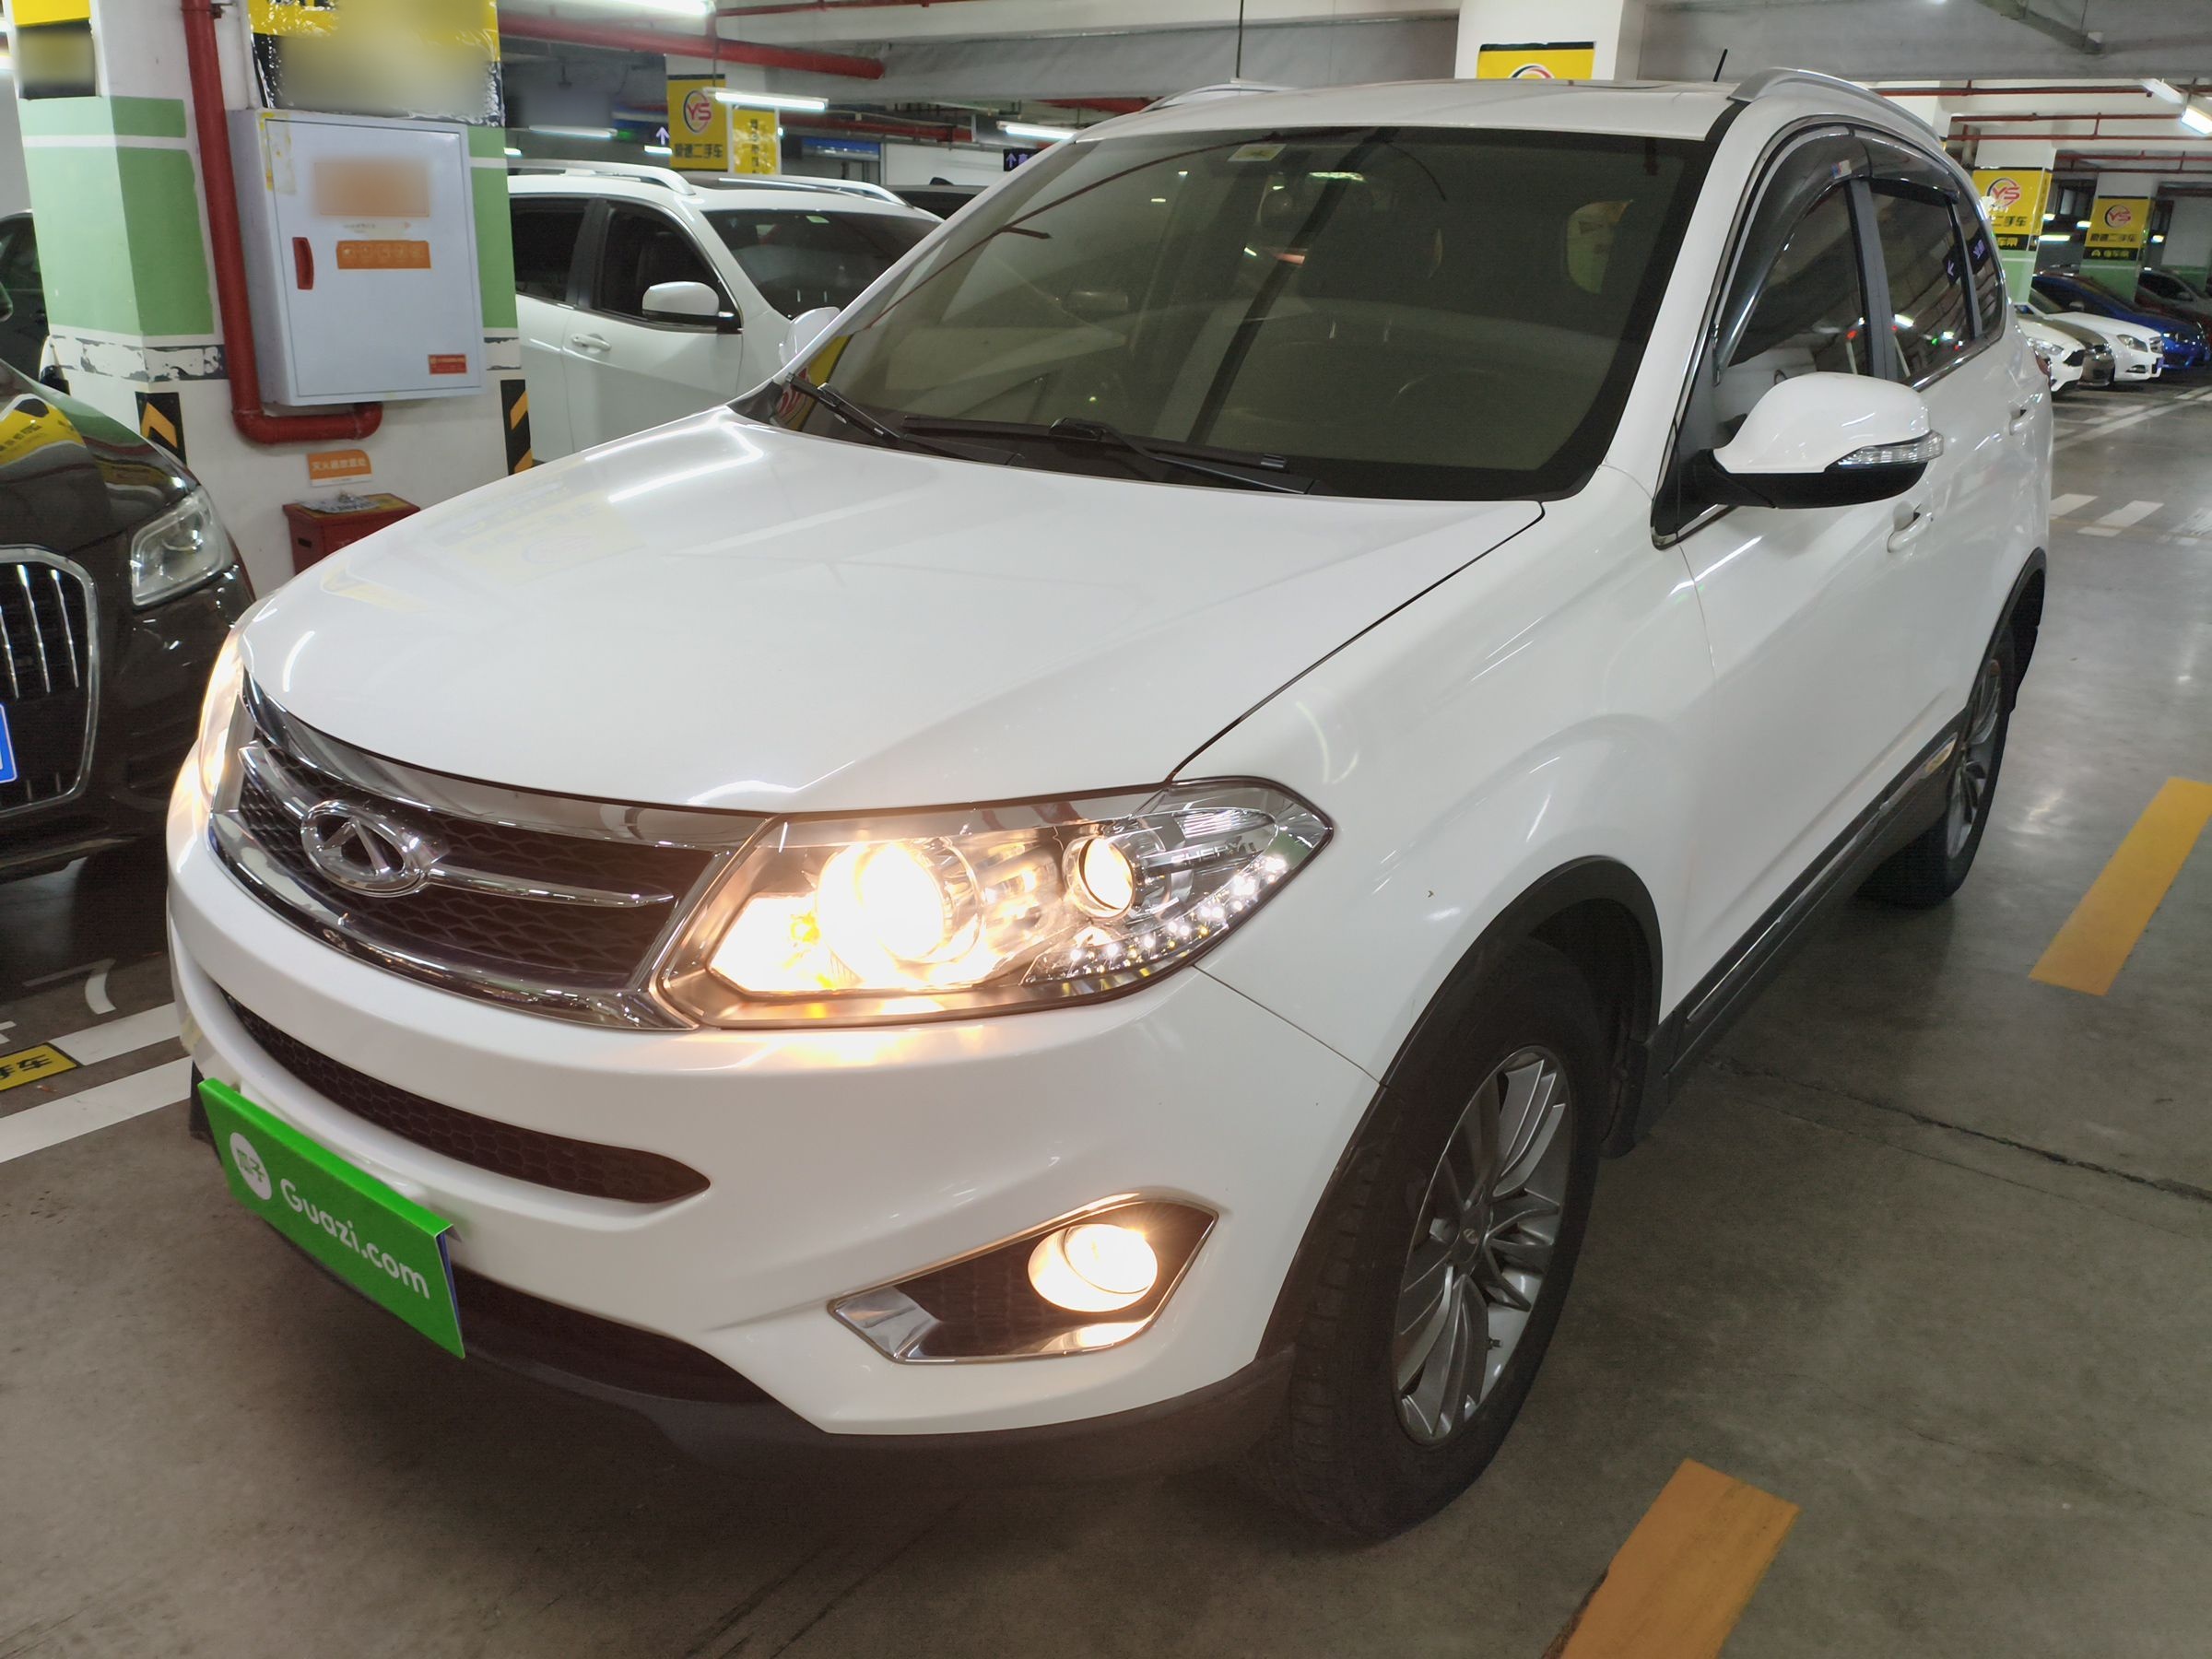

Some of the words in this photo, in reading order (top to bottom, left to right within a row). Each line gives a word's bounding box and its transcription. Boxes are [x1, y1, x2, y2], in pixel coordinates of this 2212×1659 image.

[686, 102, 712, 121] YS
[1992, 186, 2020, 200] YS
[279, 1178, 430, 1300] Guazi.com
